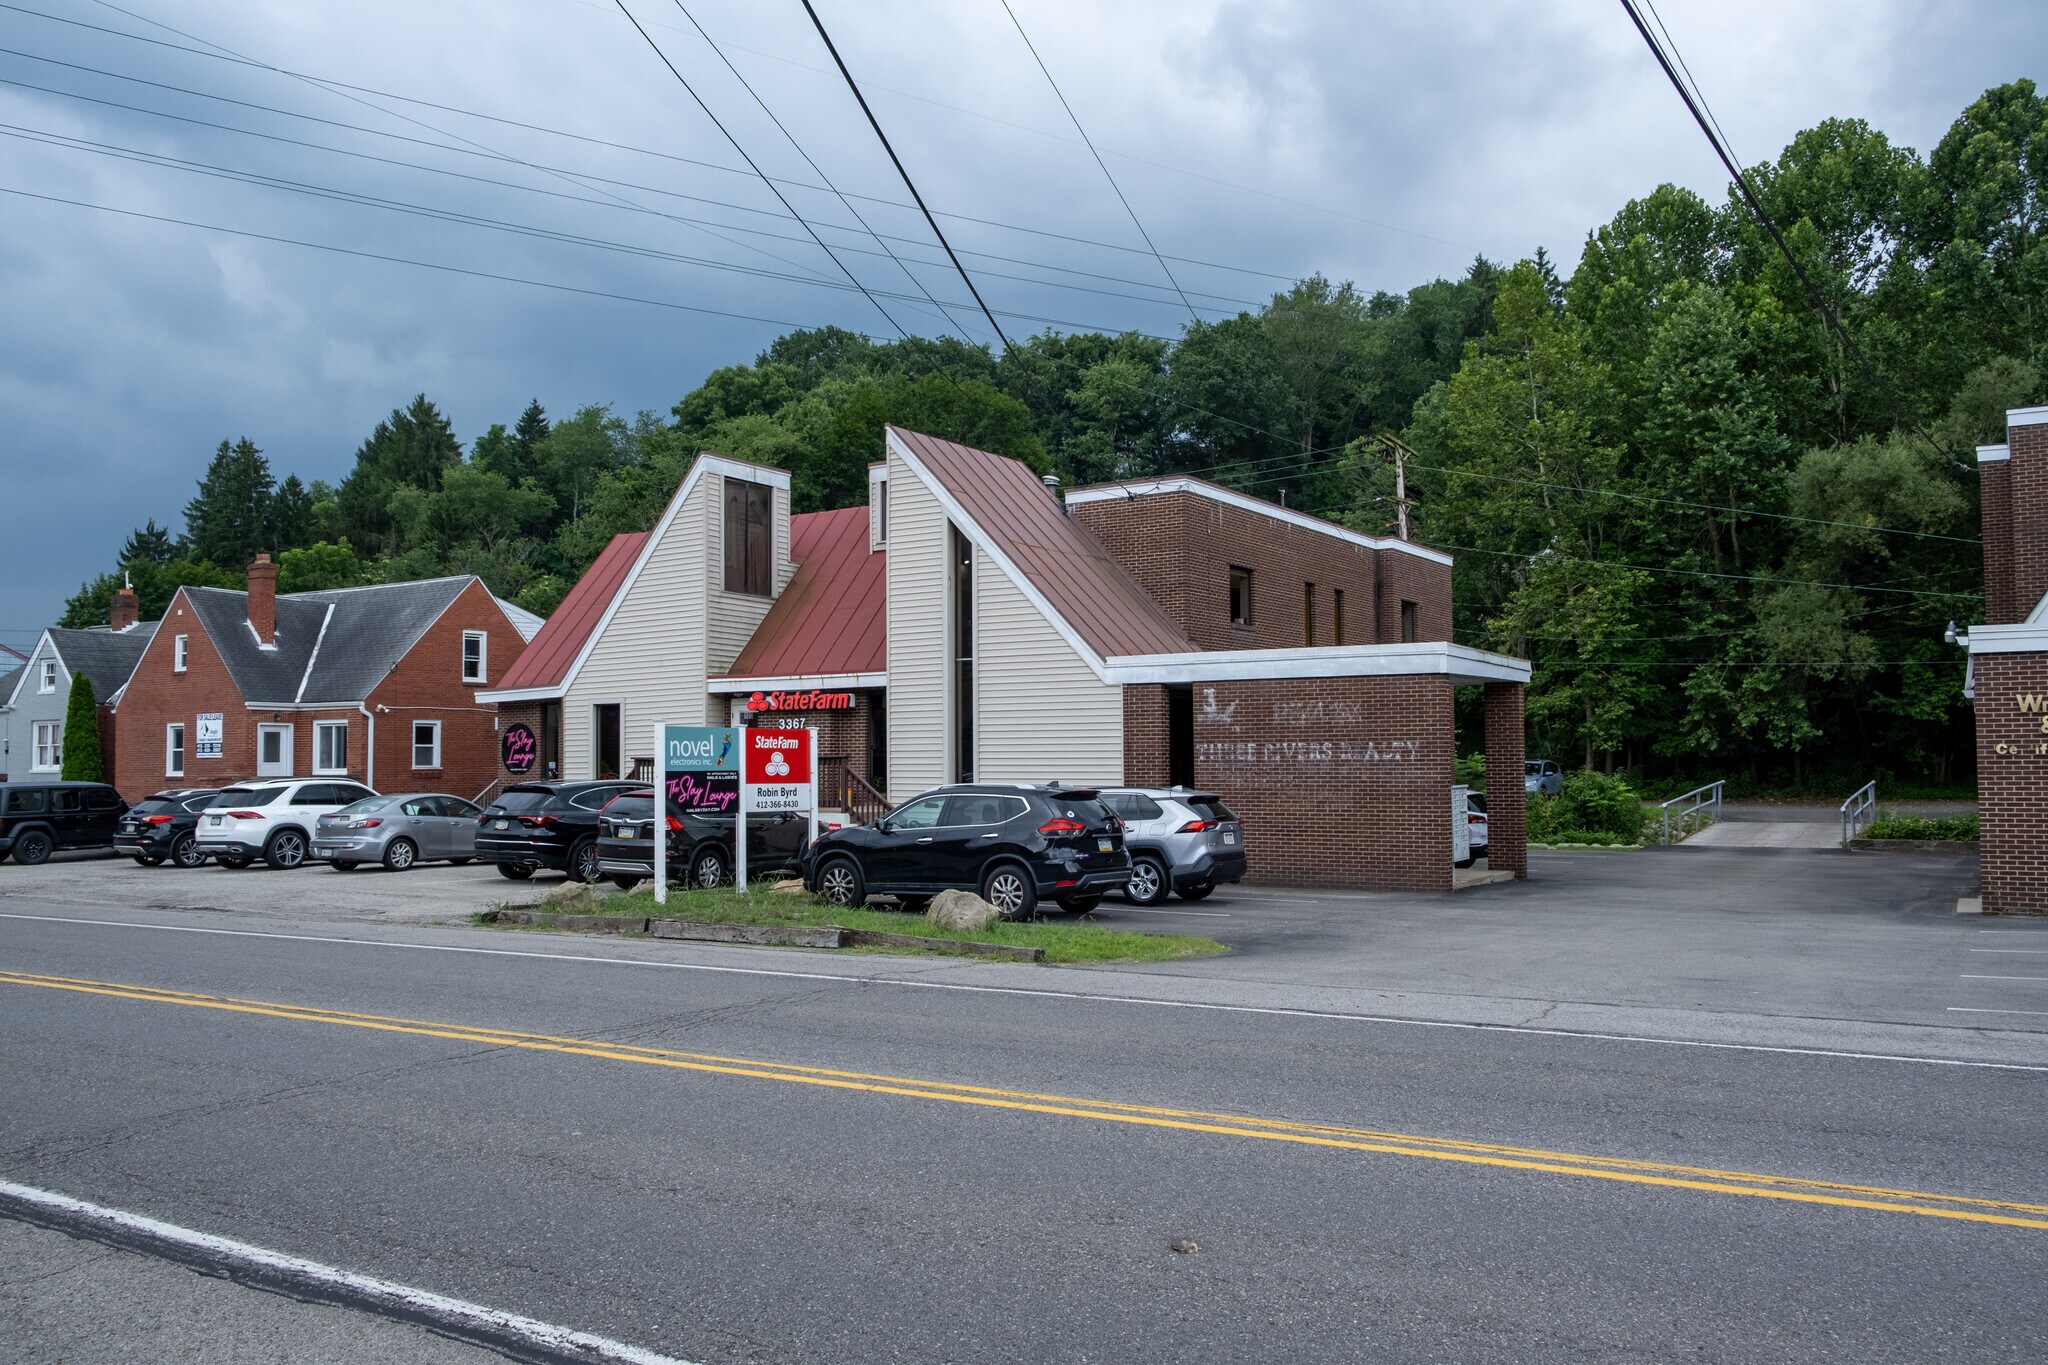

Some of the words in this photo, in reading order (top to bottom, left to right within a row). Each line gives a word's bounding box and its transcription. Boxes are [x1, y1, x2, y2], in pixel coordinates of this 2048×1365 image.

[779, 718, 806, 730] 3367
[506, 732, 517, 746] The
[514, 729, 534, 751] Slay
[670, 734, 714, 757] novel
[506, 745, 535, 767] Lounge
[670, 757, 701, 766] electronics
[702, 757, 713, 766] inc.
[666, 779, 680, 799] The
[678, 775, 704, 806] Slay
[700, 781, 737, 810] Lounge
[757, 787, 779, 797] Robin
[780, 787, 798, 799] Byrd
[756, 800, 799, 809] 412-366-8430
